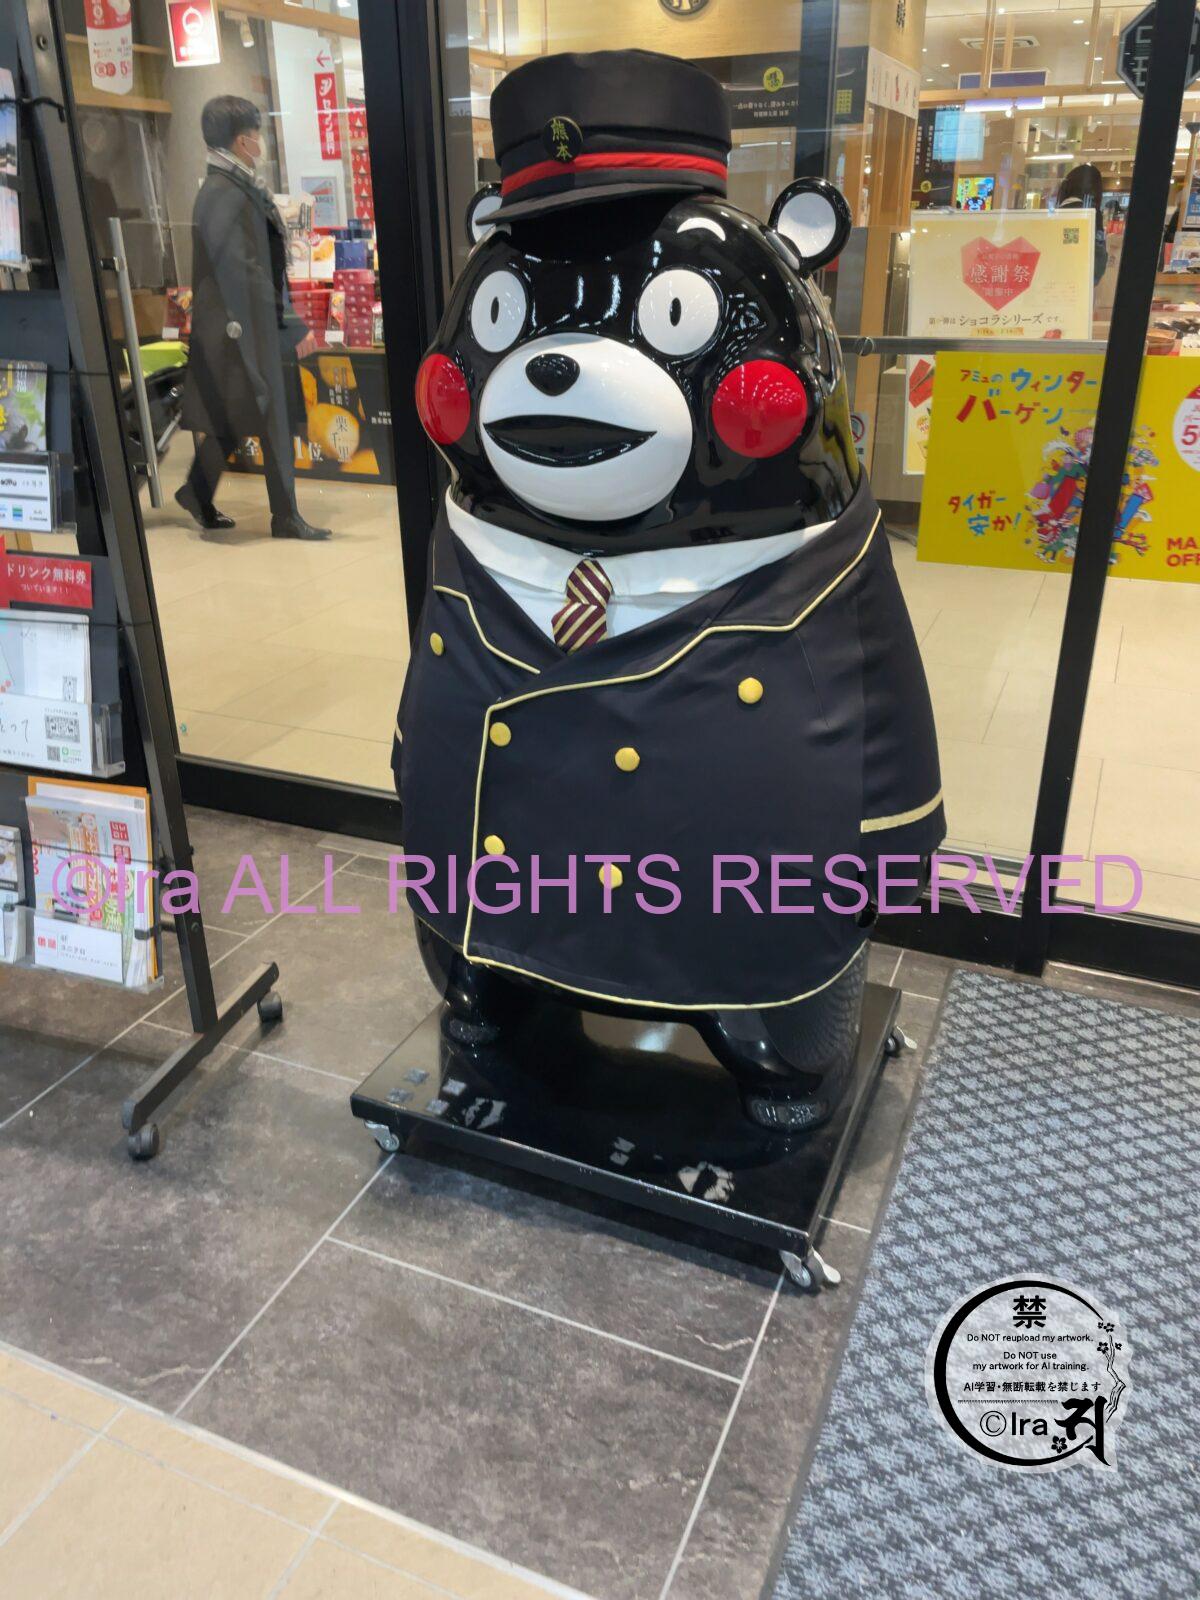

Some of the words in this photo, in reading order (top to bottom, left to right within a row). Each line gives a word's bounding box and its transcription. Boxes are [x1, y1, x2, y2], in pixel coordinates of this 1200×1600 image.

[551, 118, 573, 160] 熊本
[969, 263, 1031, 284] 感謝祭
[956, 388, 1064, 425] バーゲン
[1181, 424, 1200, 446] 5
[948, 490, 1007, 513] タイガー
[7, 562, 87, 584] ドリンク無料券
